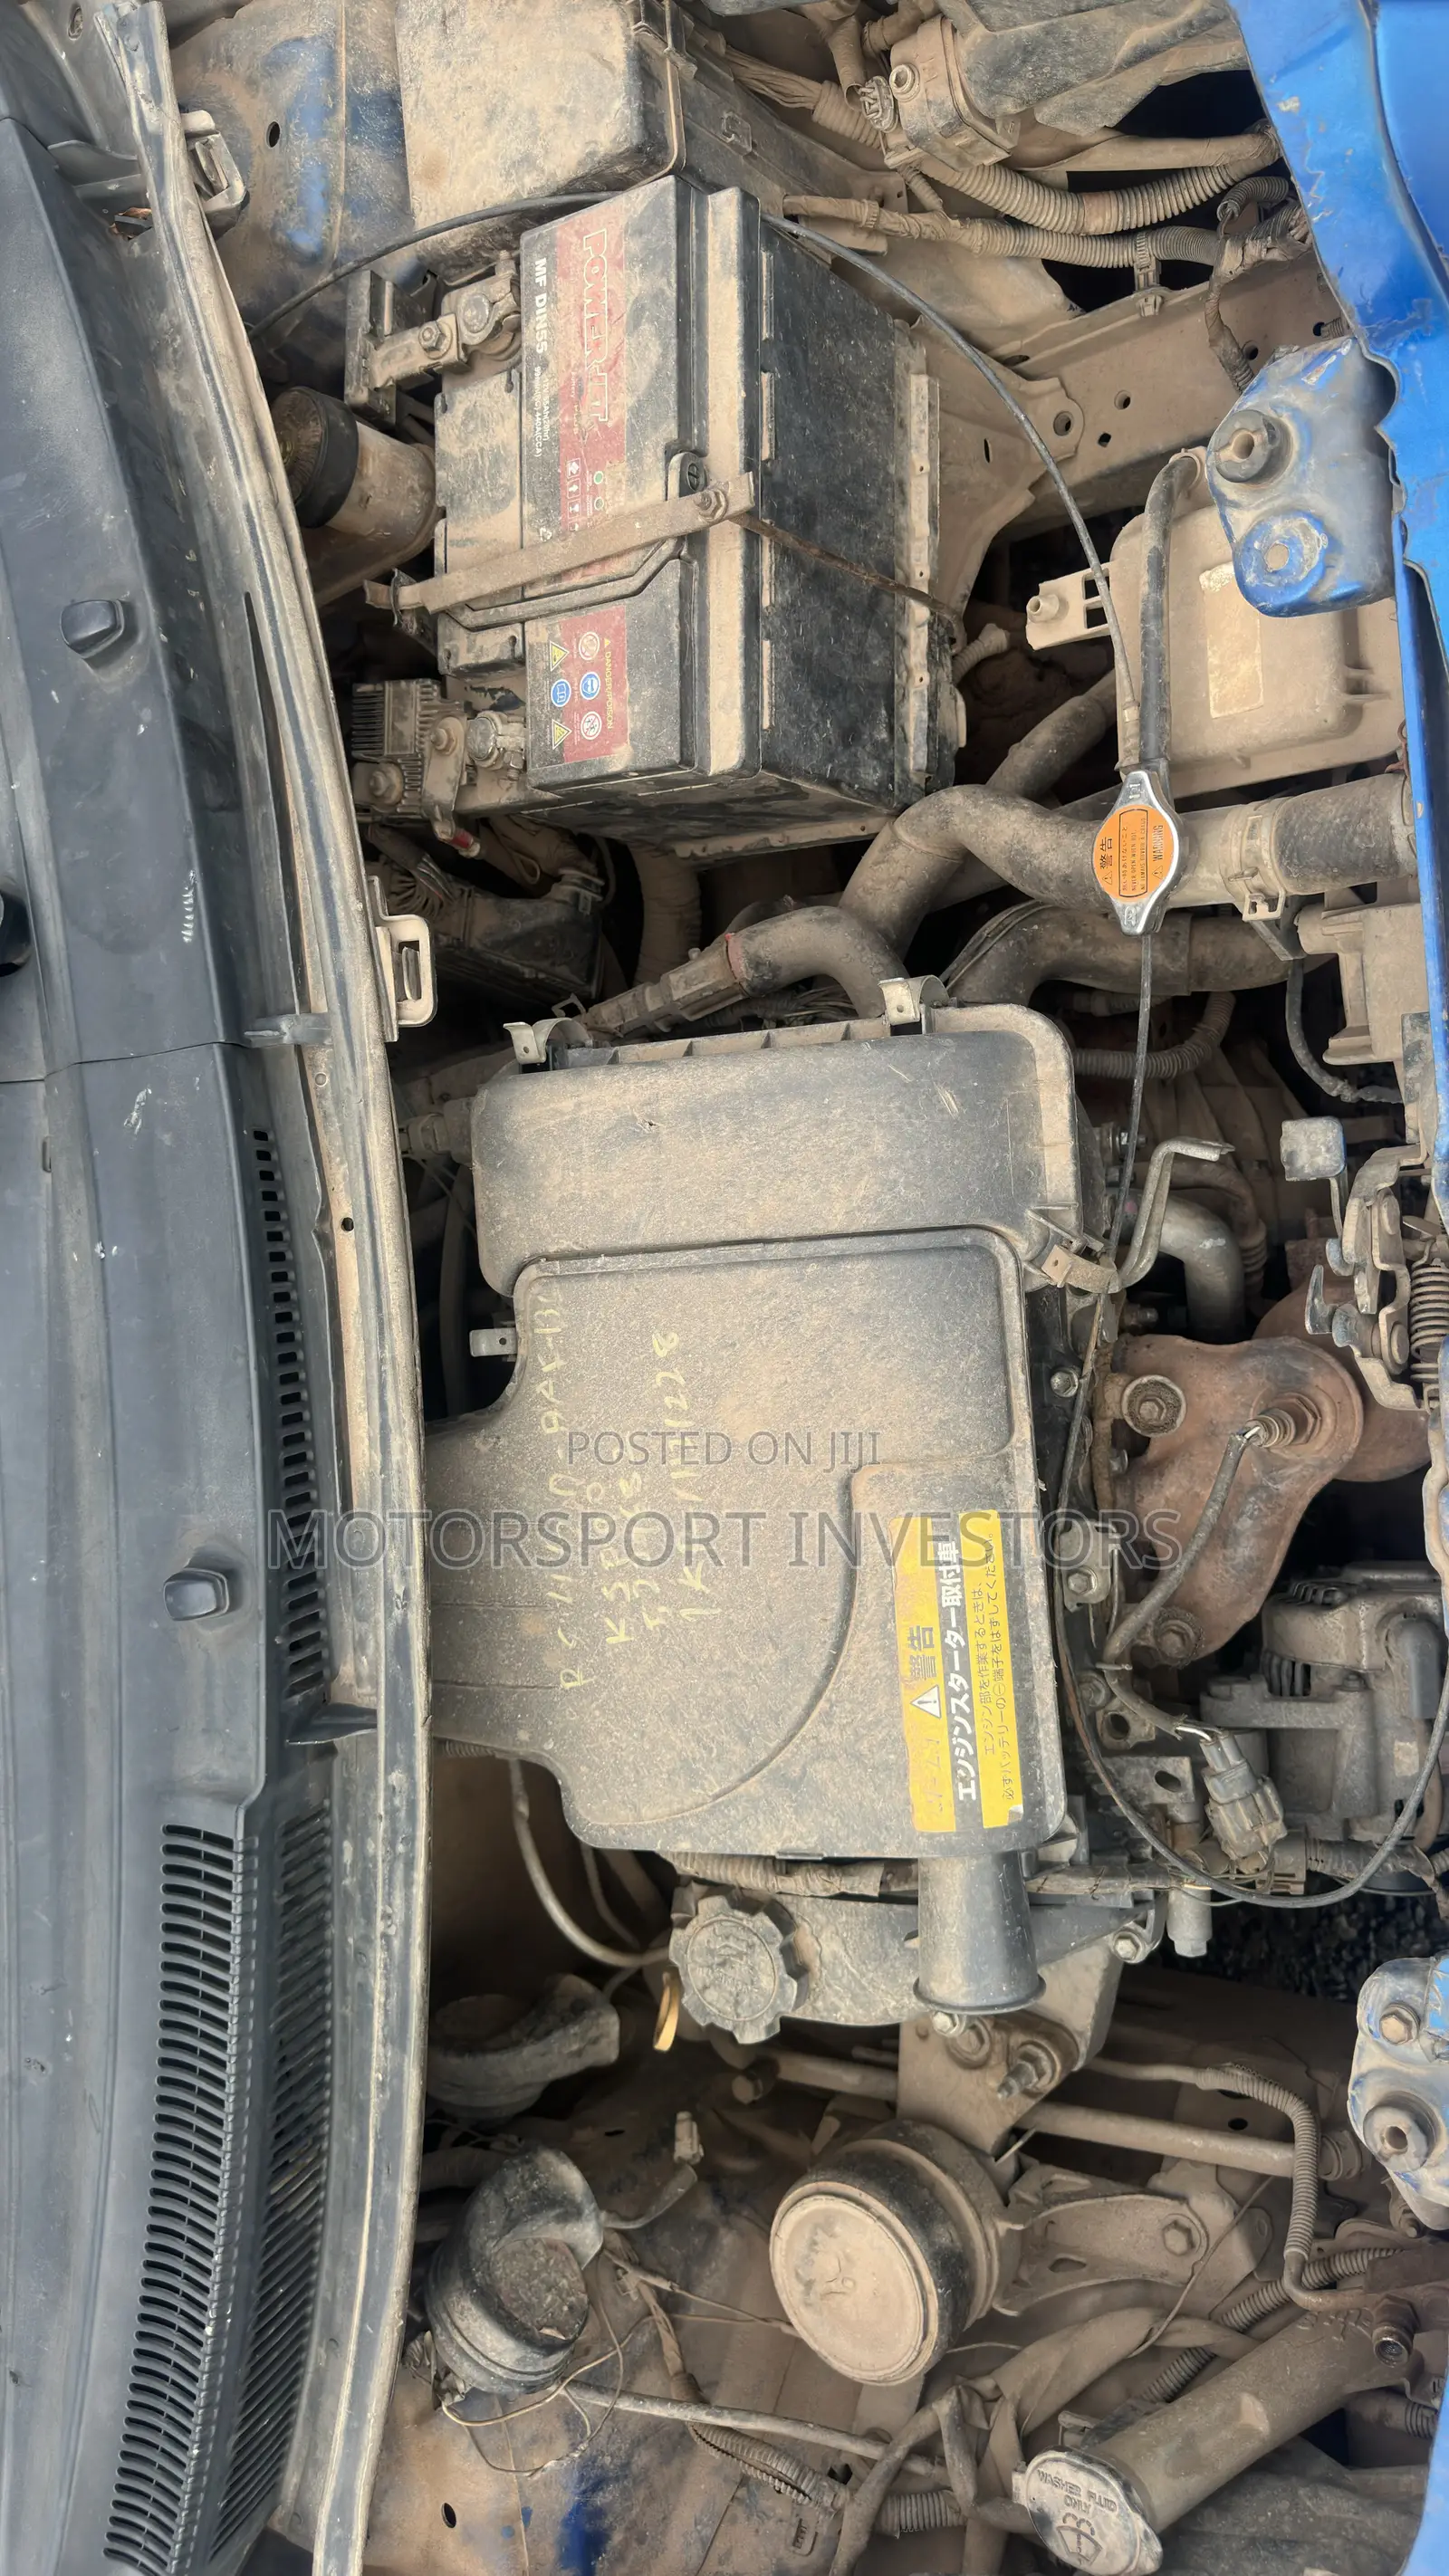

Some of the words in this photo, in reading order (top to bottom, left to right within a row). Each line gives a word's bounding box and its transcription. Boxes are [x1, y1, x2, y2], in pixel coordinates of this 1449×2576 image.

[534, 257, 547, 287] MF
[535, 295, 548, 354] DIN55
[604, 651, 614, 730] DANGER/POISON
[1099, 837, 1113, 869] 警告
[1152, 825, 1164, 862] WARNING
[907, 1624, 937, 1681] 警告
[936, 1540, 977, 1801] エンジンスターター取付車
[971, 1581, 996, 1756] エンジン部を作業するときは、
[1037, 2468, 1082, 2495] WASHER
[1087, 2490, 1118, 2513] FLUID
[1064, 2495, 1092, 2514] ONLY
